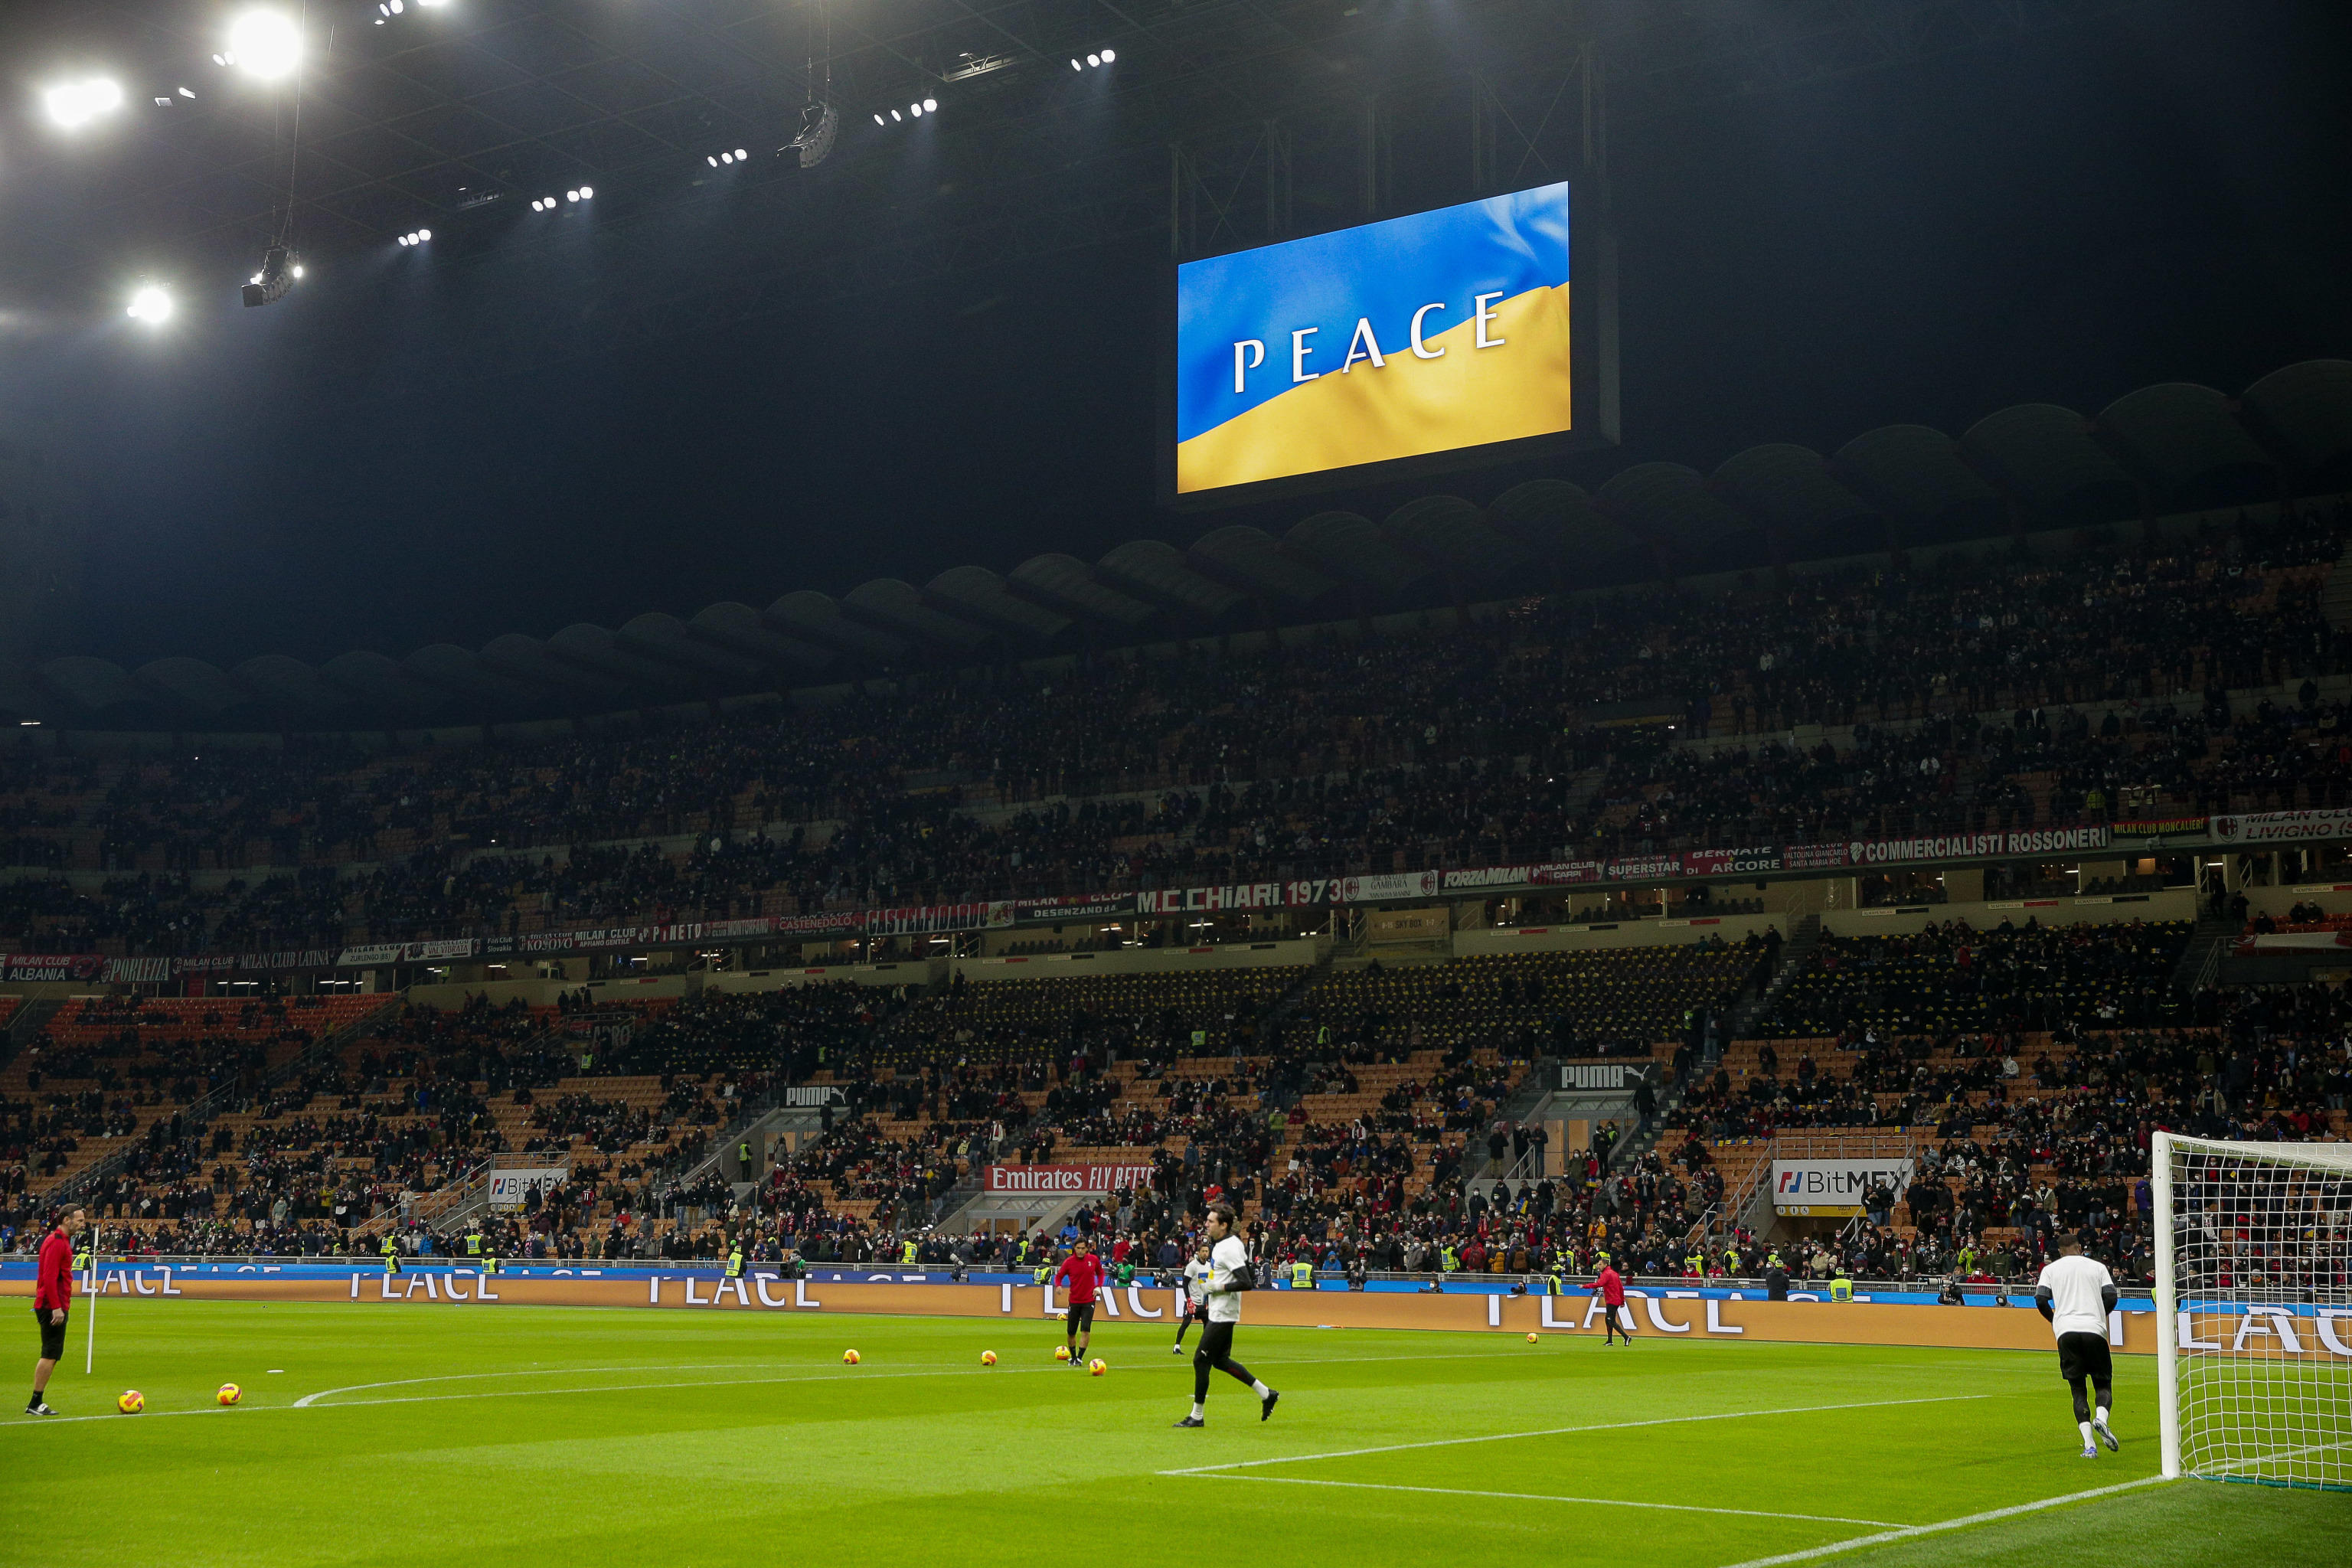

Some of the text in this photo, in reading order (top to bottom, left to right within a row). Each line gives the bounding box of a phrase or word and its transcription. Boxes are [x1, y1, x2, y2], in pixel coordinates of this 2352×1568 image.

[1233, 290, 1506, 394] PEACE
[2114, 818, 2205, 835] MILAN CLUB MONCALIERI
[2246, 823, 2332, 840] LIVIGNO
[1866, 826, 2106, 862] COMMERCIALISTI ROSSONERI
[1693, 847, 1772, 859] BERNATE
[1815, 848, 1848, 858] GIANCARLO
[1540, 861, 1595, 872] MILAN CLUB
[1608, 861, 1681, 876] SUPERSTAR
[1686, 859, 1781, 875] DI ARCORE
[1553, 871, 1581, 879] CARPI
[1370, 880, 1408, 890] GAMBARA
[1288, 879, 1341, 906] 1973
[1018, 897, 1060, 907] MILAN
[1034, 906, 1102, 918] DESENZANO
[779, 917, 851, 930] CASTENEDOLO
[867, 903, 988, 935] CASTELFIDARDO
[575, 927, 636, 941] MILAN CLUB
[711, 929, 727, 937] CLUB
[428, 944, 469, 955] VAL VIBRATA
[487, 944, 512, 952] Slovakia
[527, 937, 573, 952] KOSOVO
[580, 939, 605, 948] APPIANO
[11, 956, 70, 965] MILAN CLUB
[183, 956, 234, 967] MILAN CLUB
[240, 949, 330, 969] MILAN CLUB LATINA
[350, 953, 379, 962] ZURLENGO
[9, 967, 67, 981] ALBANIA
[109, 957, 170, 982] PORLEZZA
[1562, 1065, 1624, 1089] PUMA
[786, 1086, 831, 1106] PUMA
[991, 1166, 1156, 1190] Emirates FLY BETTE
[583, 1192, 590, 1200] 11
